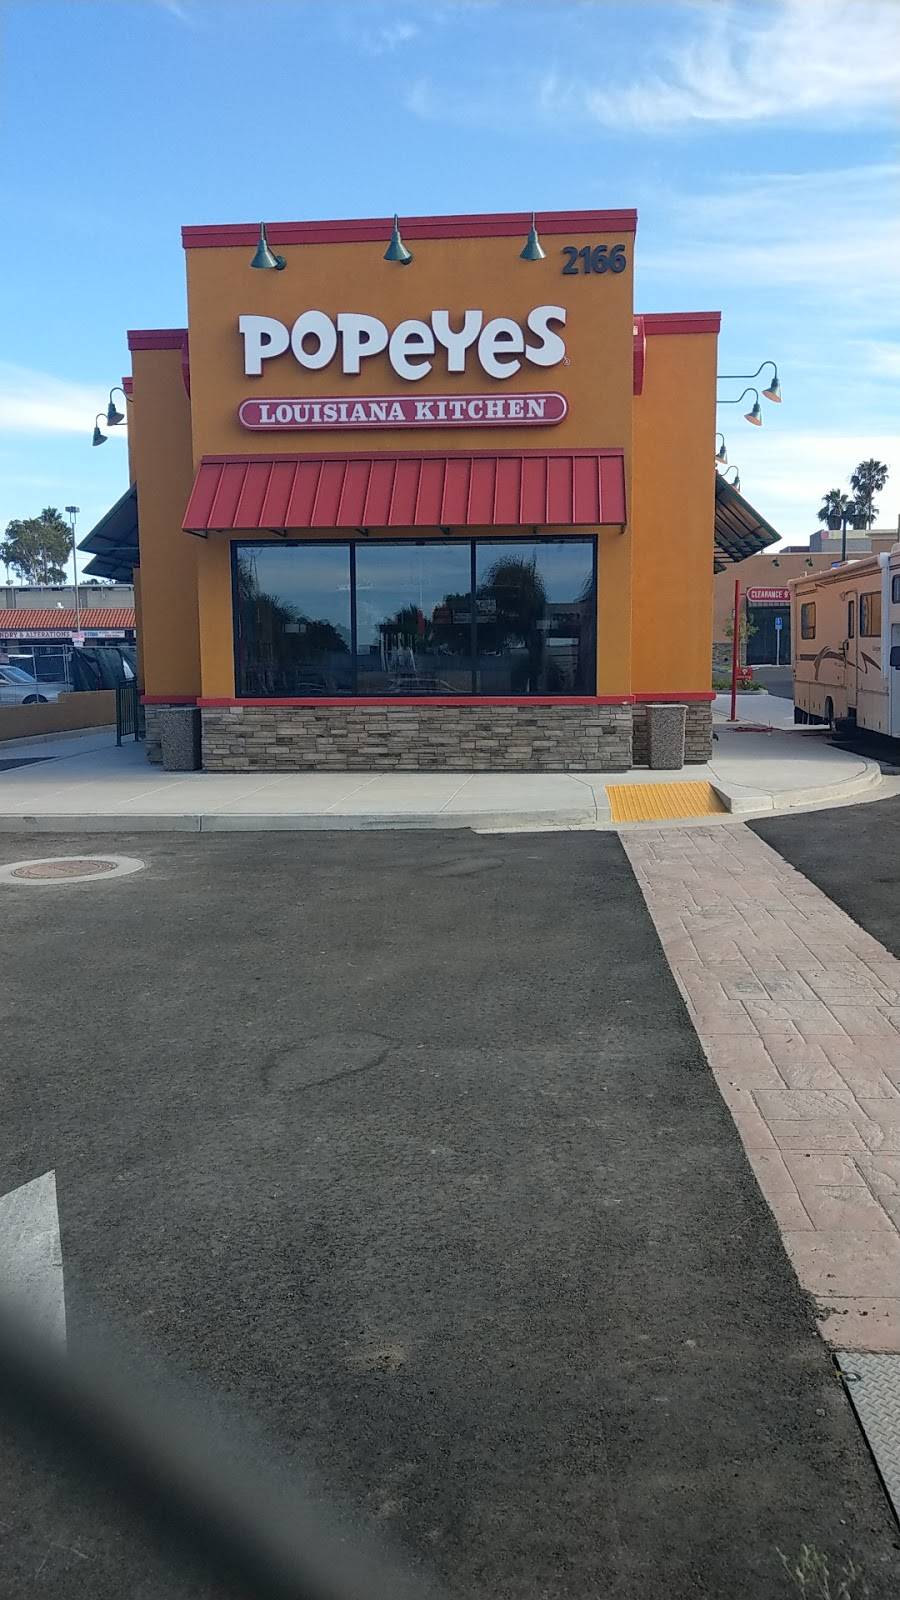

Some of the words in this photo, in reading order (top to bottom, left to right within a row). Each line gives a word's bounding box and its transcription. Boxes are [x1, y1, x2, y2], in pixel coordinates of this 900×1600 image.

[562, 244, 627, 275] 2166
[259, 402, 406, 424] LOUISIANA
[414, 398, 547, 421] KITCHEN
[751, 590, 783, 599] CLEARANCE
